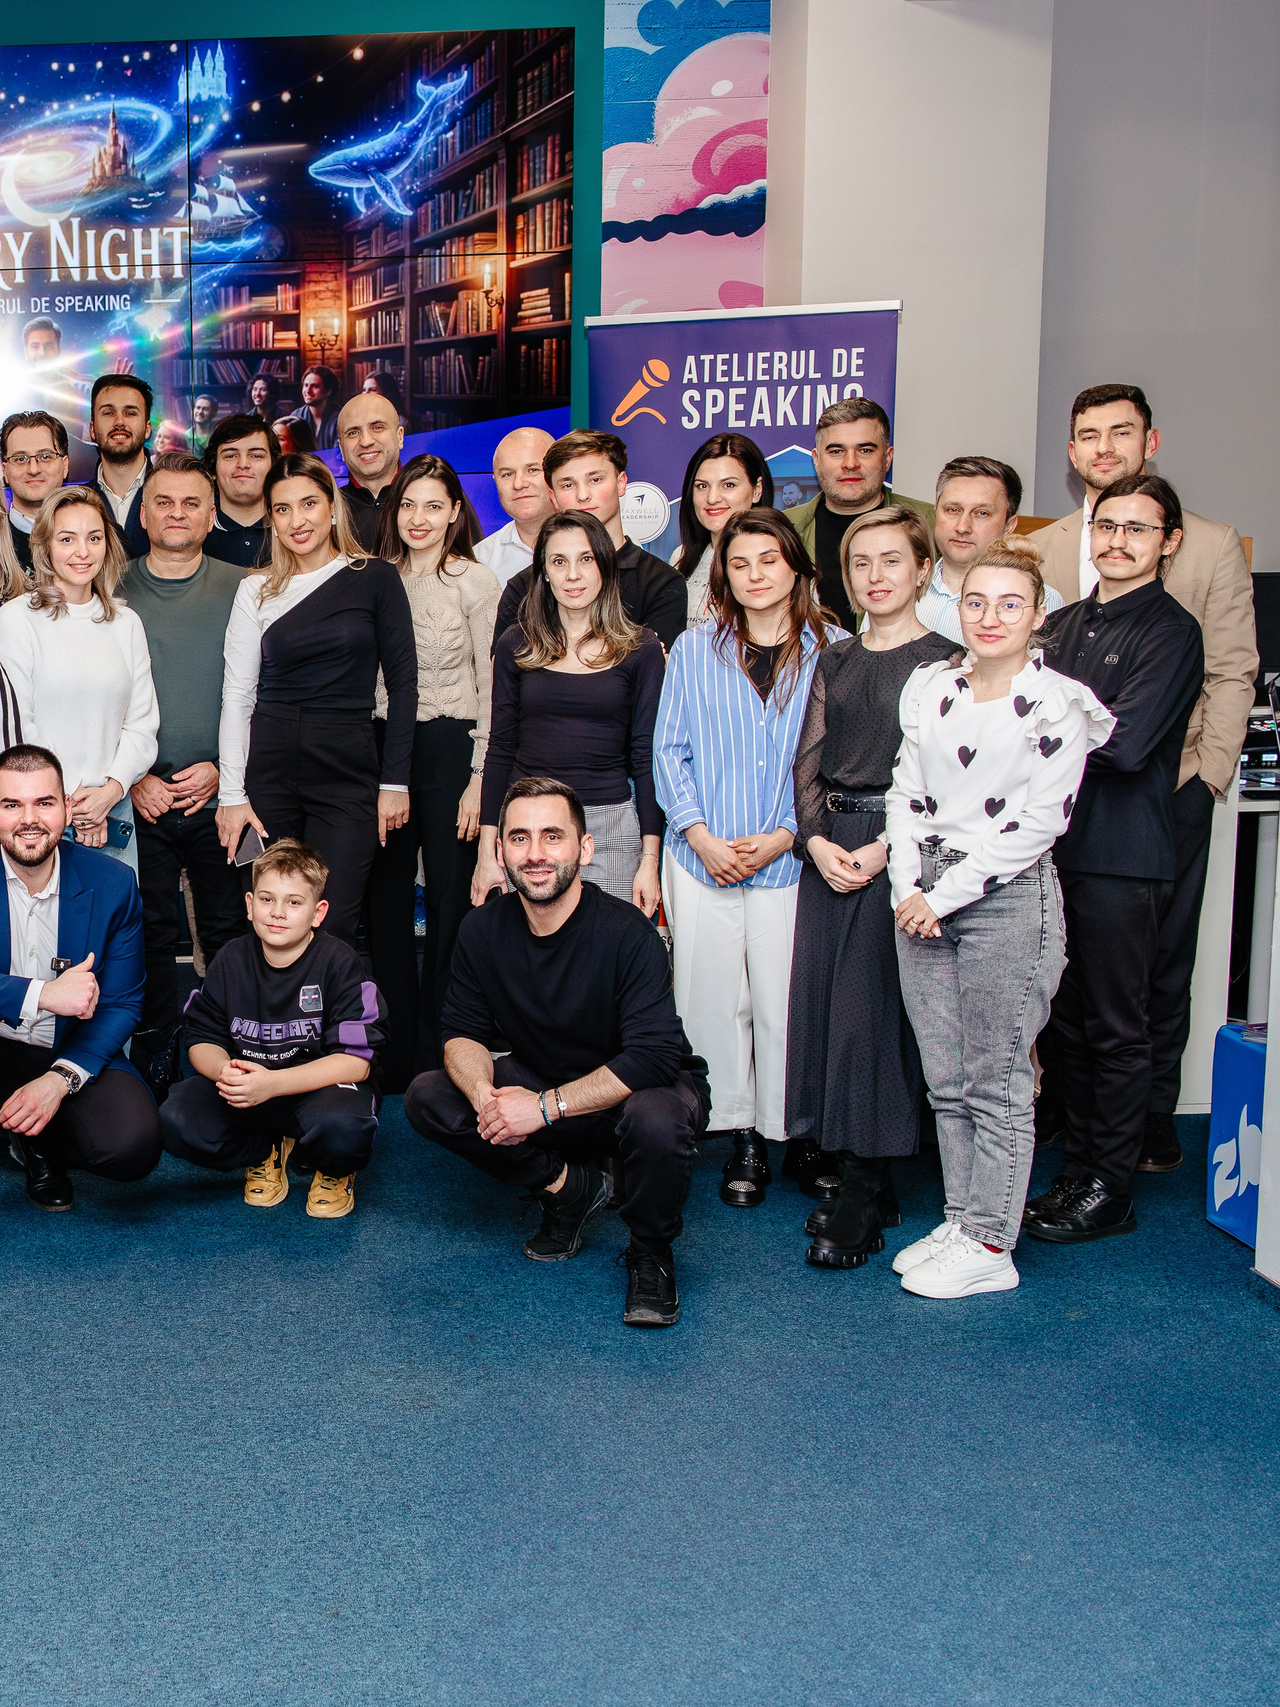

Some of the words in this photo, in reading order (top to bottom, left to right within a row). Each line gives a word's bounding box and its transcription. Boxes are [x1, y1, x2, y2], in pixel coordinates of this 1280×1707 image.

[48, 217, 194, 283] NIGHT
[31, 298, 50, 314] DE
[55, 294, 131, 313] SPEAKING
[682, 350, 822, 384] ATELIERUL
[832, 347, 866, 378] DE
[230, 1017, 322, 1042] MINECRAFT
